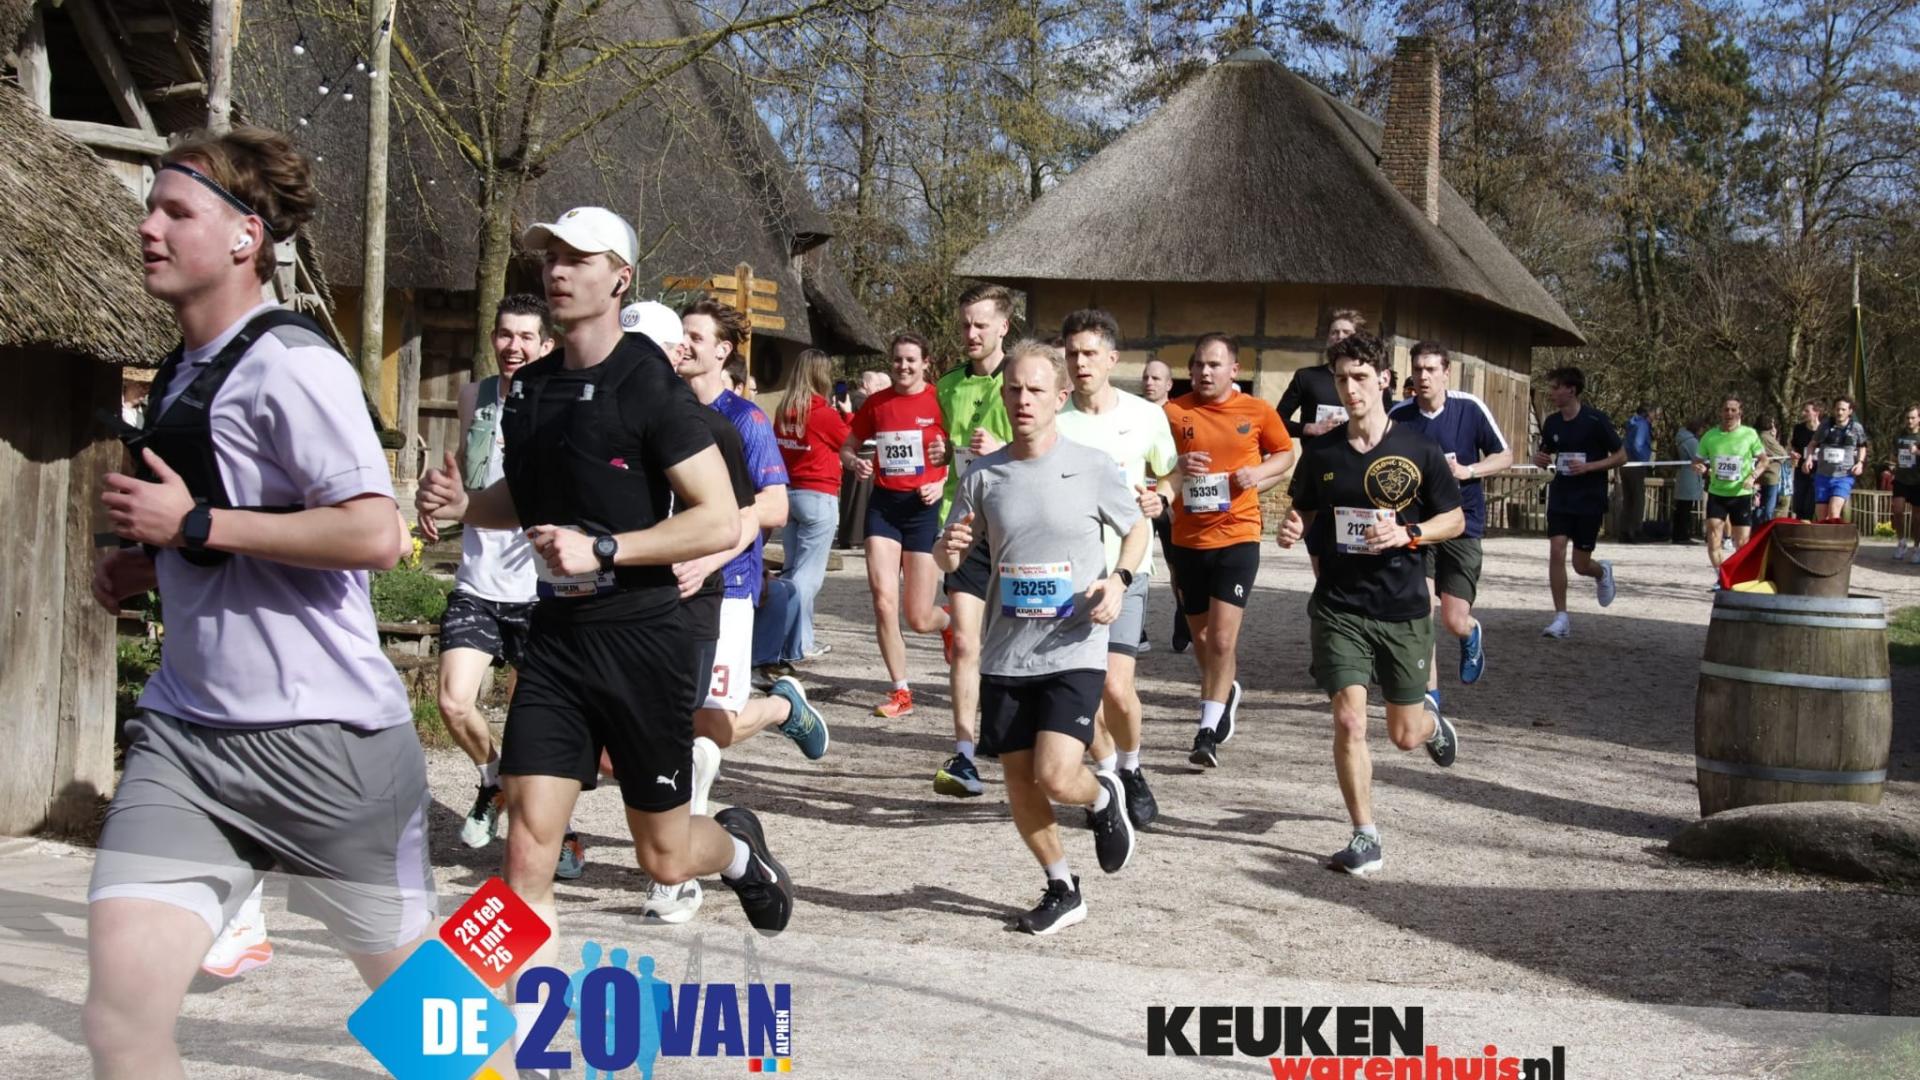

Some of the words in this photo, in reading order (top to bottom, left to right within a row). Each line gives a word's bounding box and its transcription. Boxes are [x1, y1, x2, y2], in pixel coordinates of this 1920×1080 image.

[1181, 426, 1194, 440] 14
[885, 444, 913, 459] 2331
[1189, 485, 1218, 498] 15335
[1012, 580, 1057, 596] 25255
[711, 664, 730, 697] 3
